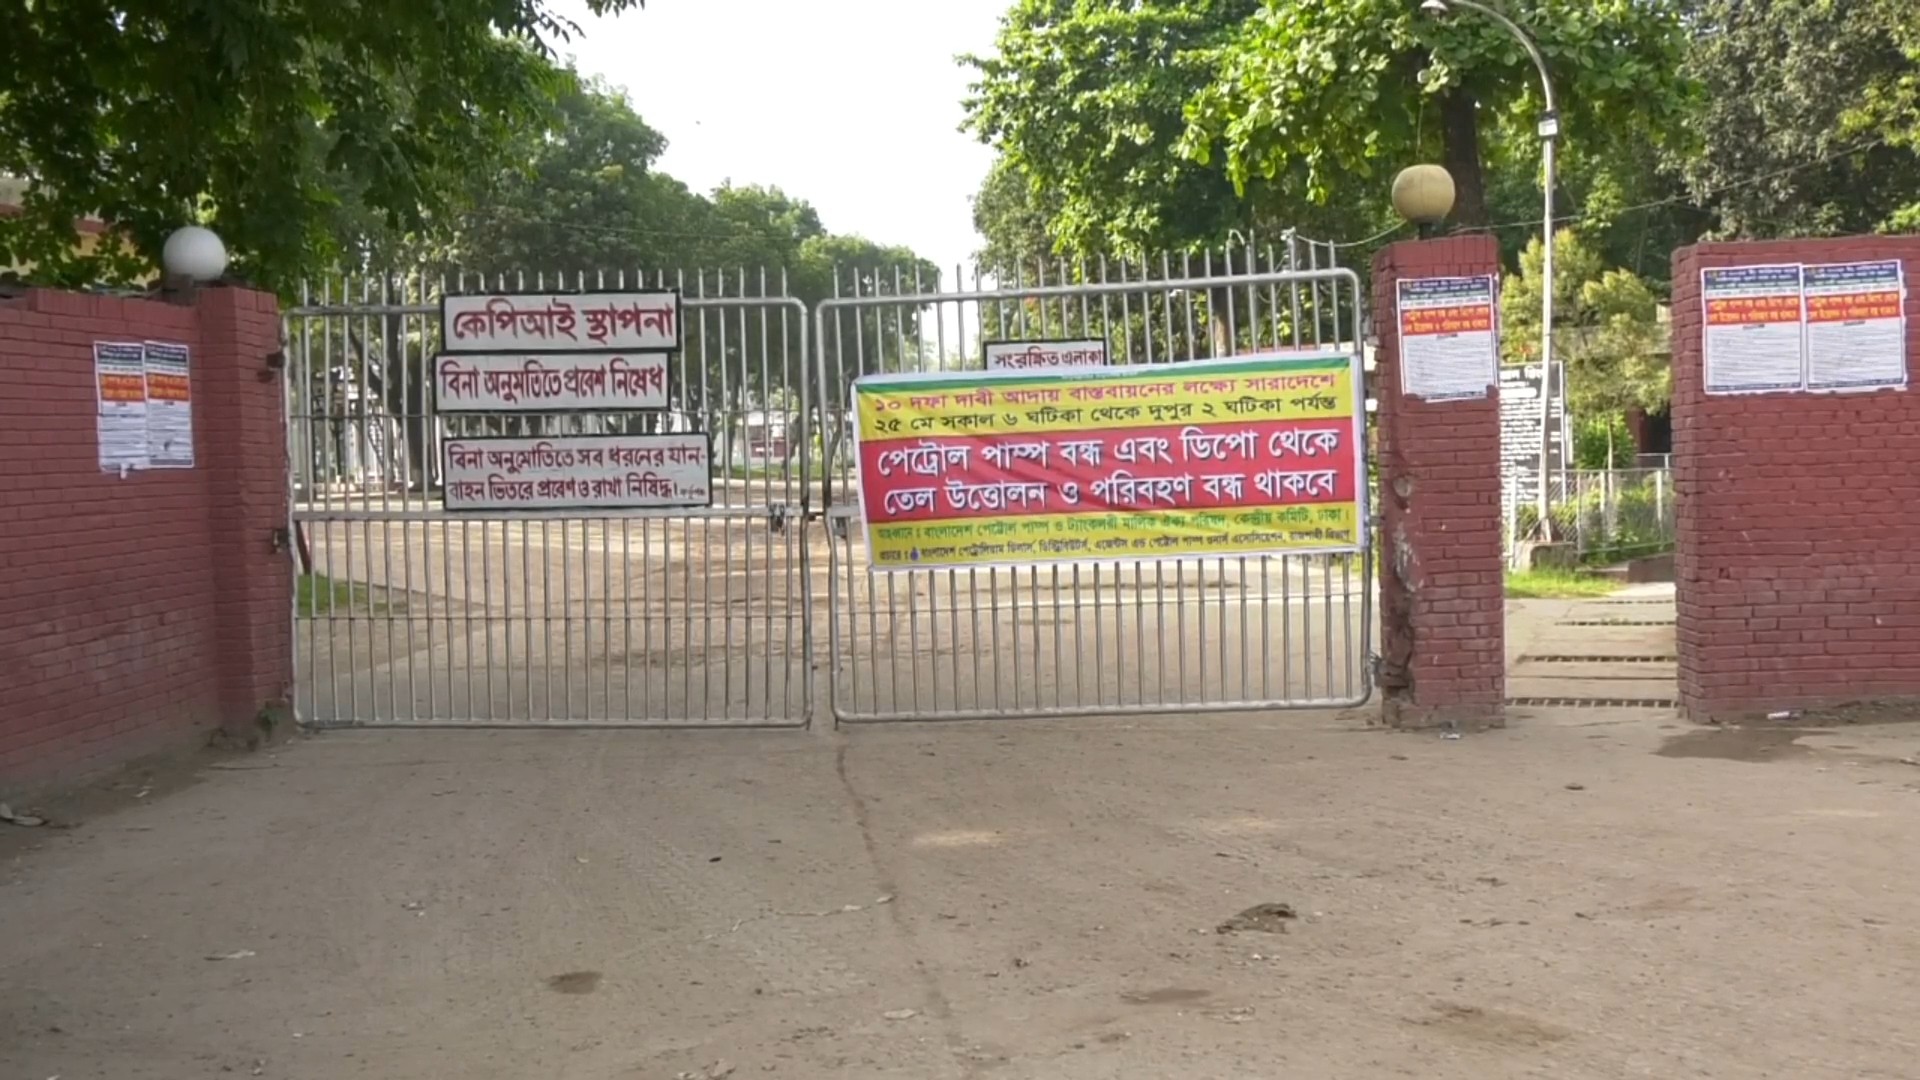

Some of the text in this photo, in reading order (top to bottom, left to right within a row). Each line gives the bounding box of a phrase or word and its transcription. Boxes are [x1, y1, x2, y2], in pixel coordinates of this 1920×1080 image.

[454, 298, 674, 345] কেপিআই স্থাপনা
[994, 345, 1105, 369] সংরক্ষিত এলাকা
[440, 358, 664, 404] বিনা অনুমতিতে প্রবেশ নিষেধ
[875, 373, 1336, 412] ১০ দফা দাবী আদায় বাস্তবায়নের লক্ষ্যে সারাদেশে
[874, 391, 1337, 433] ২৫ মে সকাল ৬ ঘটিকা থেকে দুপুর ২ ঘটিকা পর্যন্ত
[448, 443, 484, 469] বিনা
[577, 448, 603, 468] সব
[609, 445, 664, 468] ধরনের
[878, 425, 1340, 477] পেট্রোল পাম্প বন্ধ এবং ডিপো থেকে
[447, 479, 485, 501] বাহন
[488, 473, 534, 501] ভিতরে
[537, 477, 576, 498] প্রবেশ
[578, 480, 590, 498] ও
[590, 477, 622, 499] রাখা
[884, 469, 1338, 515] তেল উত্তোলন ও পরিবহণ বন্ধ থাকবে
[923, 525, 973, 538] বাংলাদেশ
